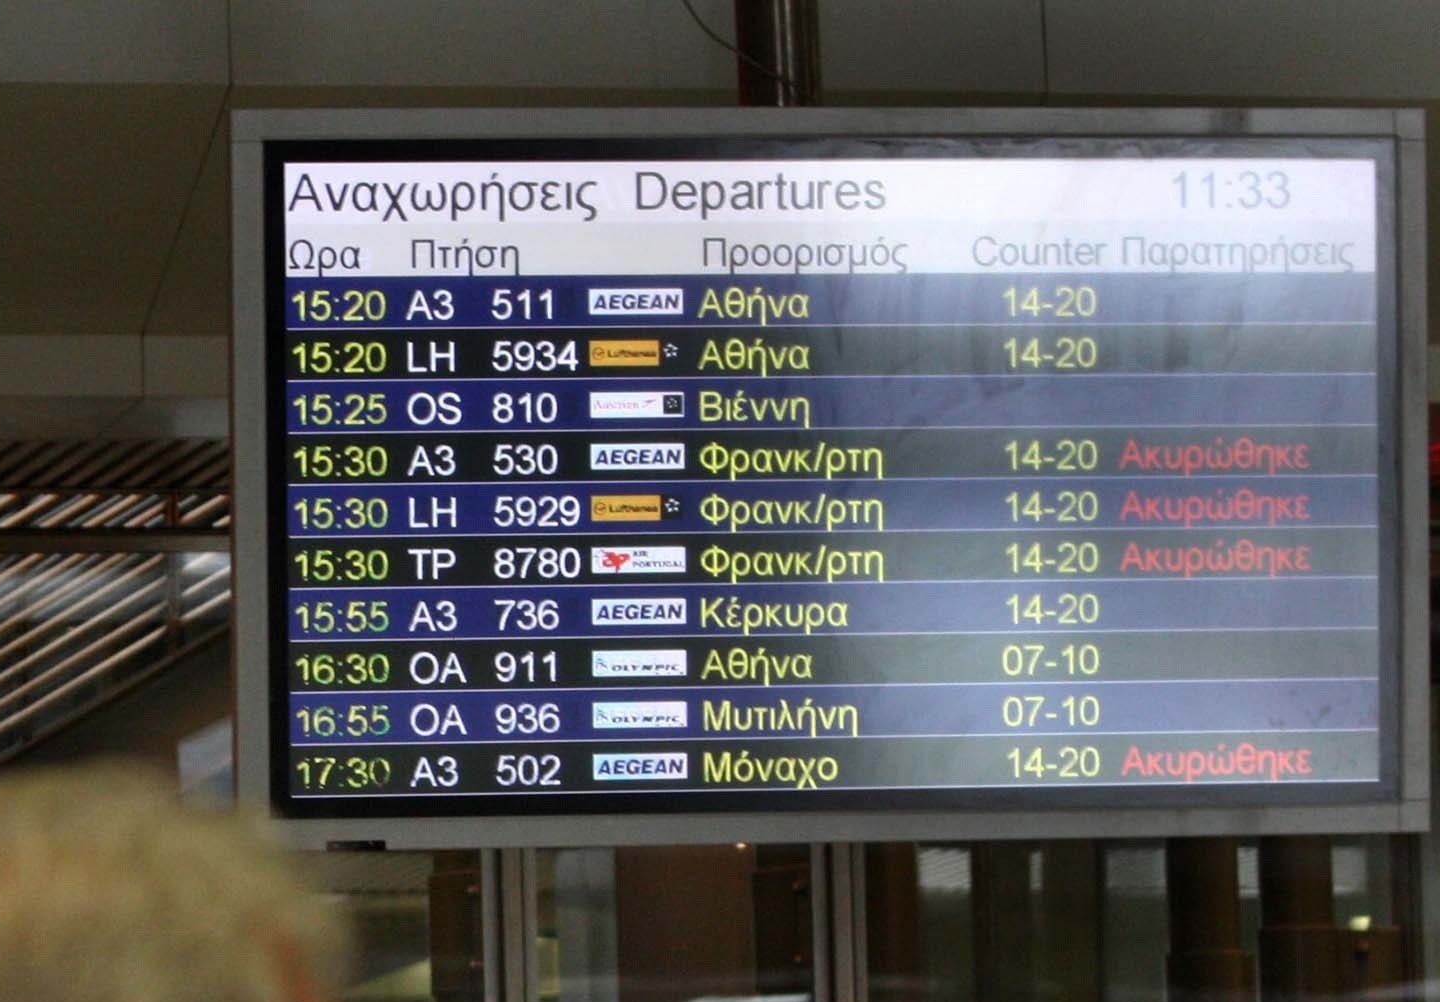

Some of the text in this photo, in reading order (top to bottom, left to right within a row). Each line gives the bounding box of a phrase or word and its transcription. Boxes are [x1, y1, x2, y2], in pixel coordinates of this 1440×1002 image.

[288, 170, 1291, 222] Αναχωρήσεις Departures 11:33
[289, 235, 1355, 274] Ωρα Πτήση Προορισμός Counter Παρατηρήσεις
[292, 286, 1096, 324] 15:20 A3 511 AEGEAN Αθήνα 14-20
[293, 337, 1096, 375] 15:20 LH 5934 Αθήνα 14-20
[293, 390, 810, 427] 15:25 OS 810 Βιέννη
[294, 437, 1308, 478] 15:30 A3 530 AEGEAN Φρανκ/ρτη 14-20 Ακυρώθηκε
[294, 488, 1309, 530] 15:30 LH 5929 Φρανκ/ρτη 14-20 Ακυρώθηκε
[295, 539, 1310, 581] 15:30 TP 8780 Φρανκ/ρτη 14-20 Ακυρώθηκε
[296, 594, 1098, 633] 15:55 A3 736 AEGEAN Κέρκυρα 14-20
[296, 645, 1099, 685] 16:30 OA 911 OLYMPIC Αθήνα 07-10
[297, 696, 1099, 736] 16:55 OA 936 OLYMPIC Μυτιλήνη 07-10
[297, 743, 1311, 789] 17:30 A3 502 AEGEAN Μόναχο 14-20 Ακυρώθηκε
